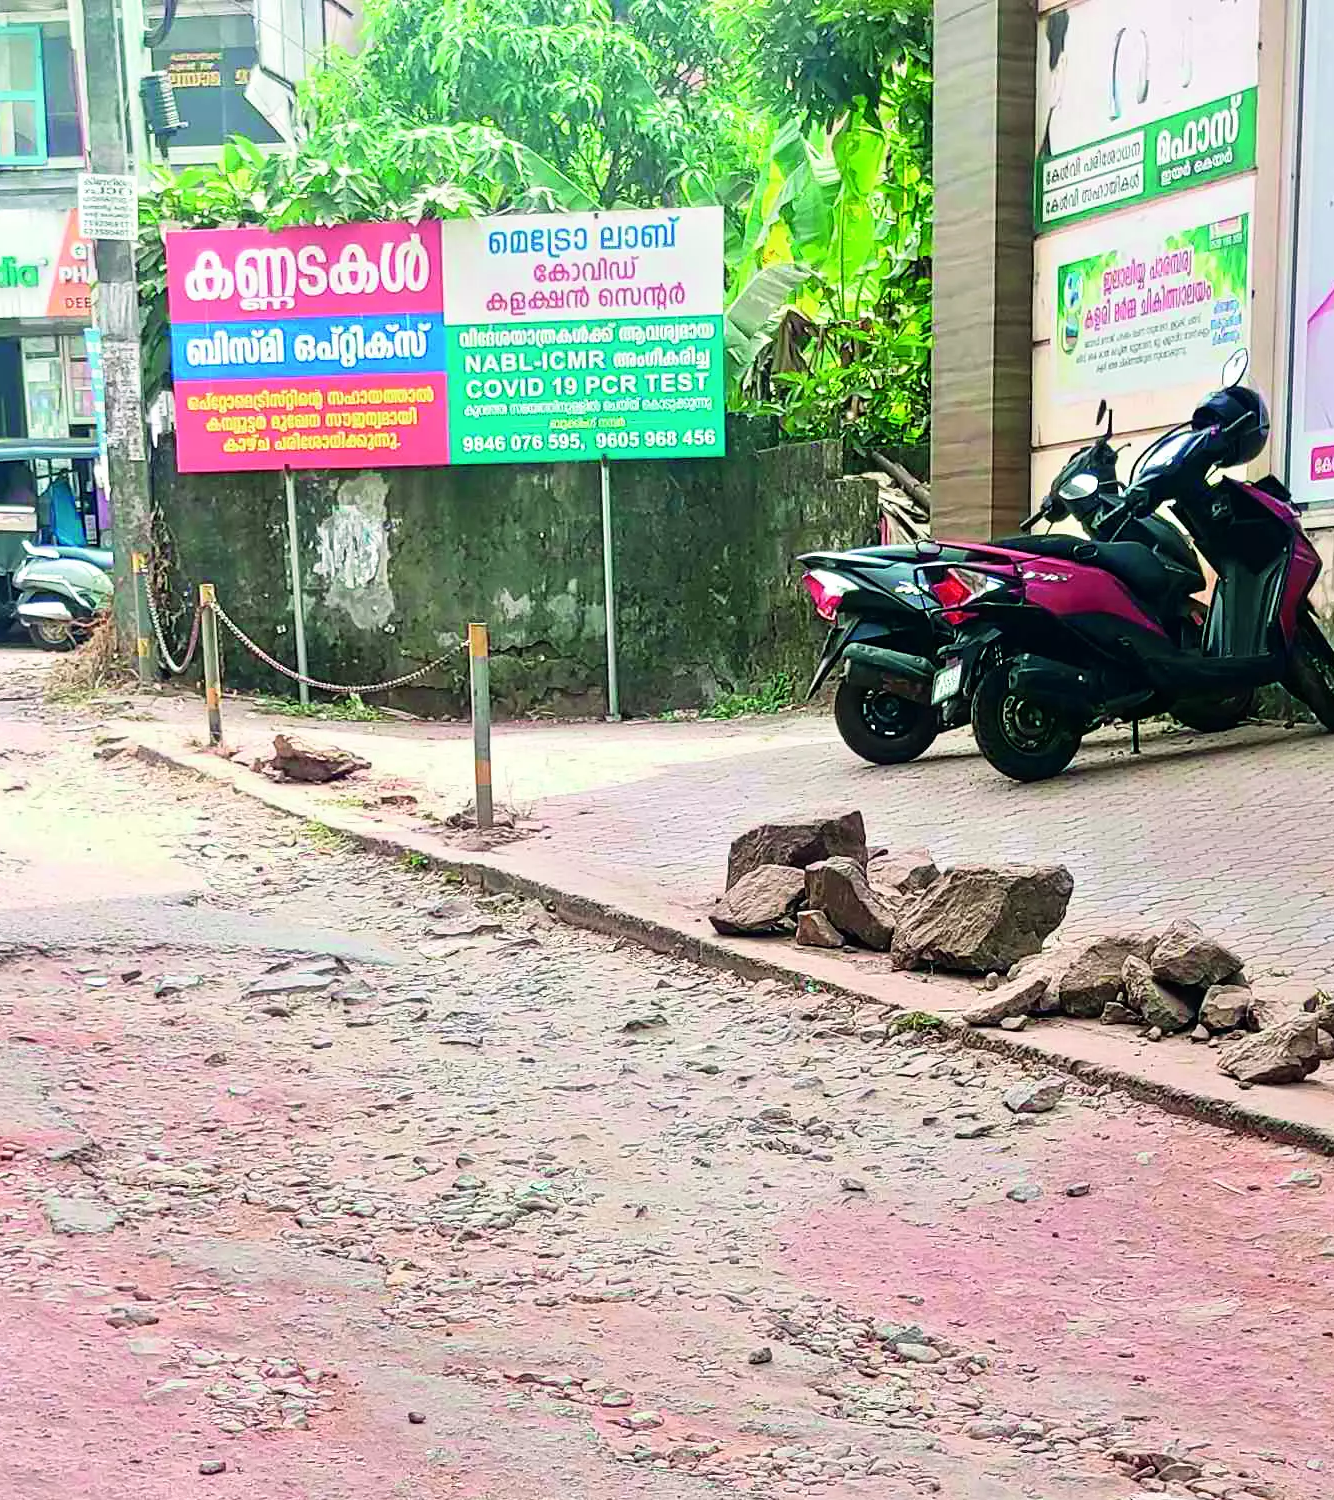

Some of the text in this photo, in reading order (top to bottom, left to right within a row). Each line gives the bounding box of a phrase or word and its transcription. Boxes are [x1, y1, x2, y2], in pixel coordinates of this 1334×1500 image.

[488, 216, 681, 258] മെട്രോ ലാബ്
[184, 233, 431, 311] കണ്ണടകൾ
[533, 255, 640, 284] കോവിഡ്
[486, 286, 590, 315] കളക്ഷൻ
[186, 328, 285, 367] ബിസ്മി
[464, 350, 607, 374] NABL-ICMR
[465, 372, 711, 400] COVID 19 PCR TEST
[462, 429, 716, 453] 9846 076 595, 9605 968 456
